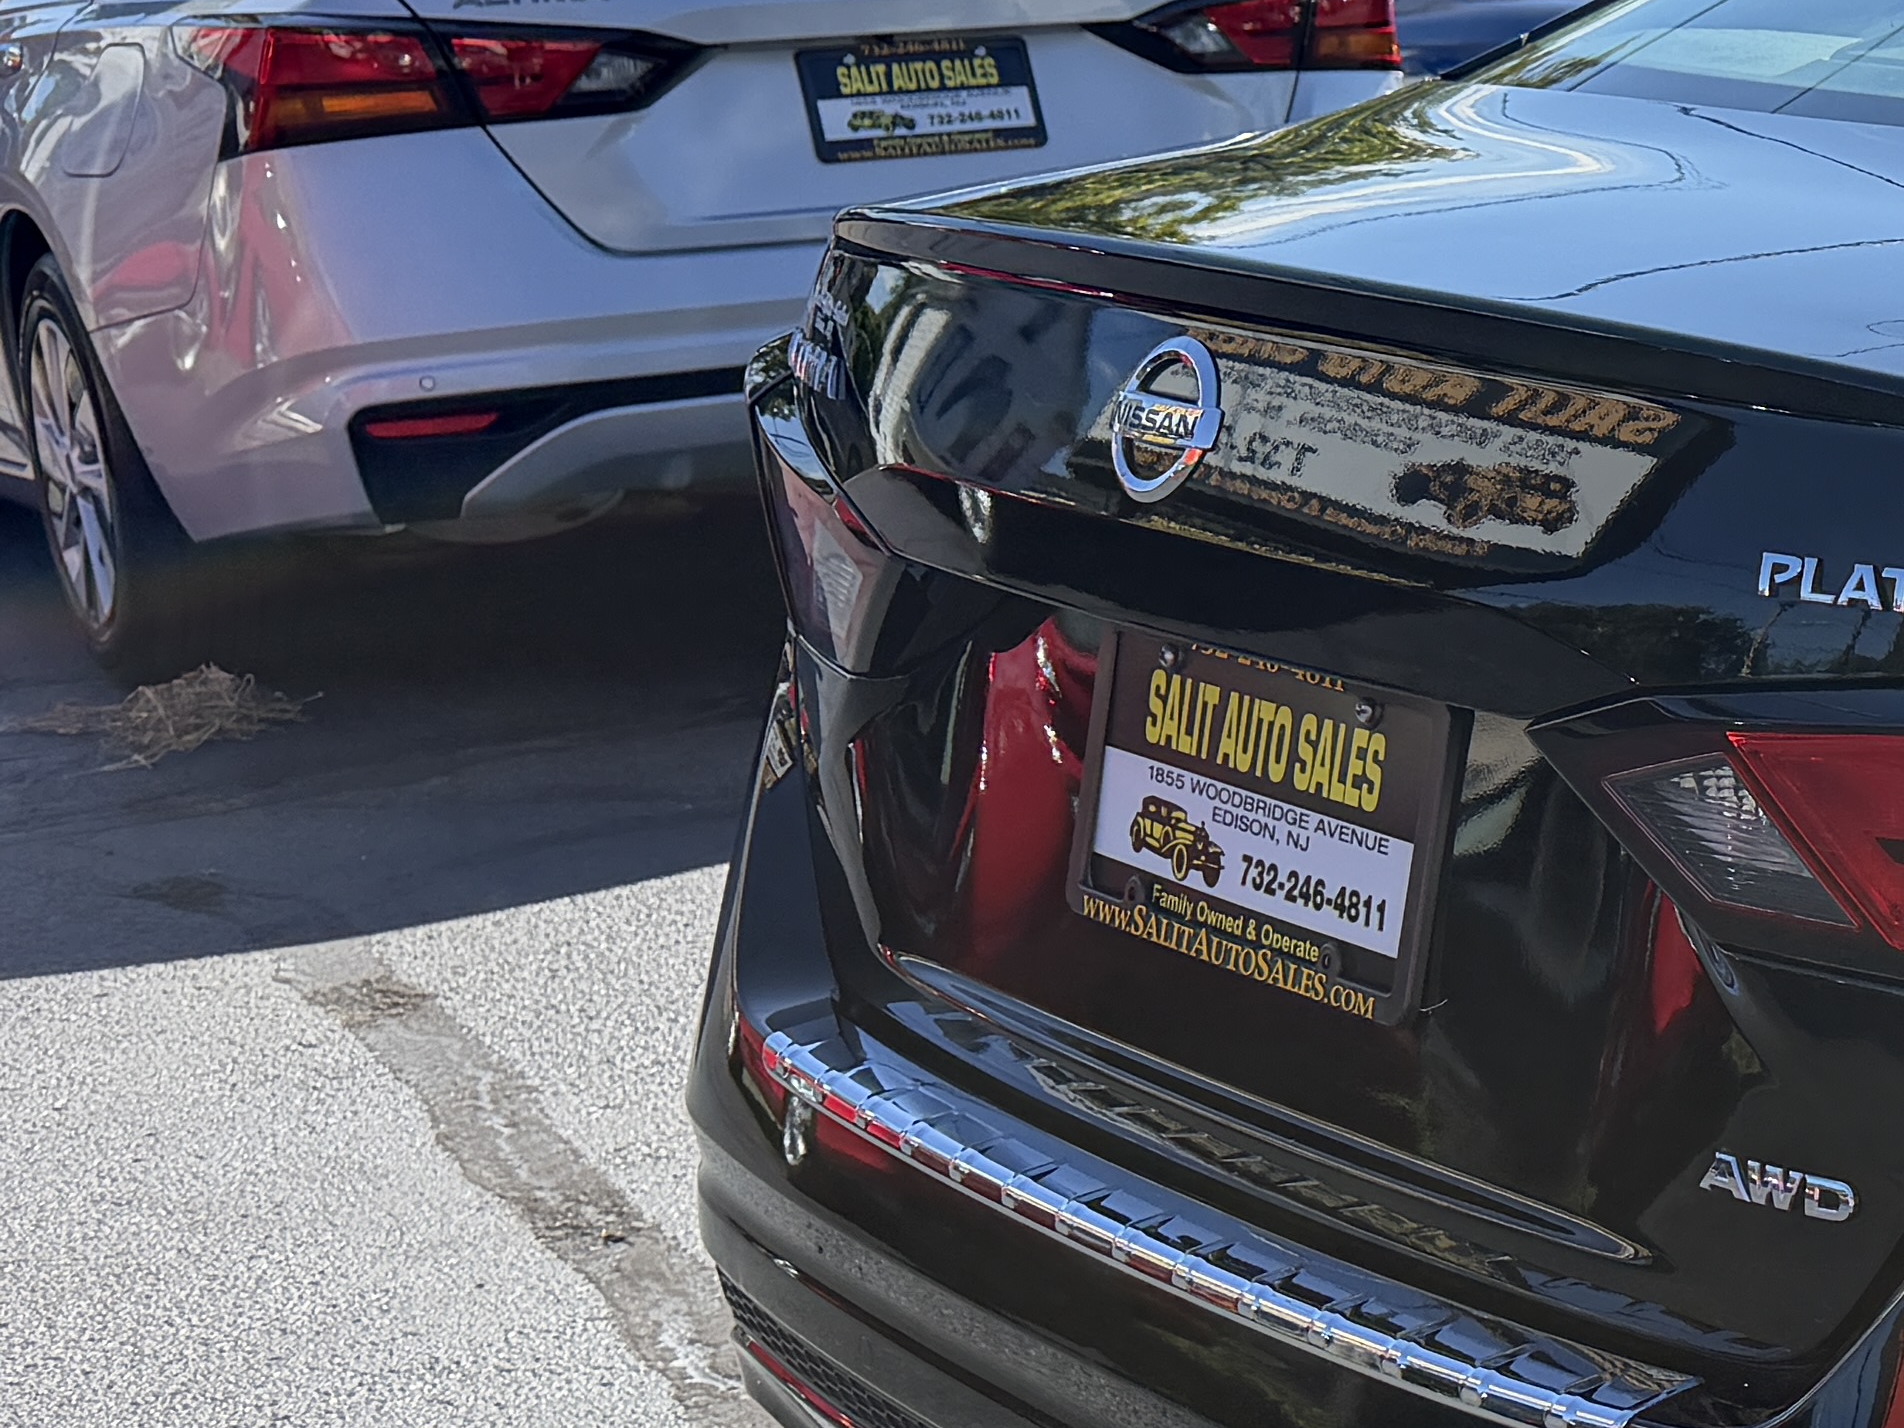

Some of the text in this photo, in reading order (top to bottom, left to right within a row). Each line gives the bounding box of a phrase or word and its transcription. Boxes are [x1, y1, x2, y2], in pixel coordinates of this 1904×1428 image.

[837, 56, 999, 95] SALIT AUTO SALES
[1109, 395, 1204, 439] NISSAN
[1145, 668, 1386, 813] SALIT AUTO SALES
[1148, 765, 1390, 856] 1855 WOODBRIDGE AVENUE
[1211, 805, 1310, 853] EDISON, NJ
[1152, 883, 1194, 921] Family
[1197, 900, 1242, 936] Owned
[1246, 918, 1256, 942] &
[1240, 853, 1387, 932] 732-246-4811
[1698, 1150, 1859, 1222] AWD
